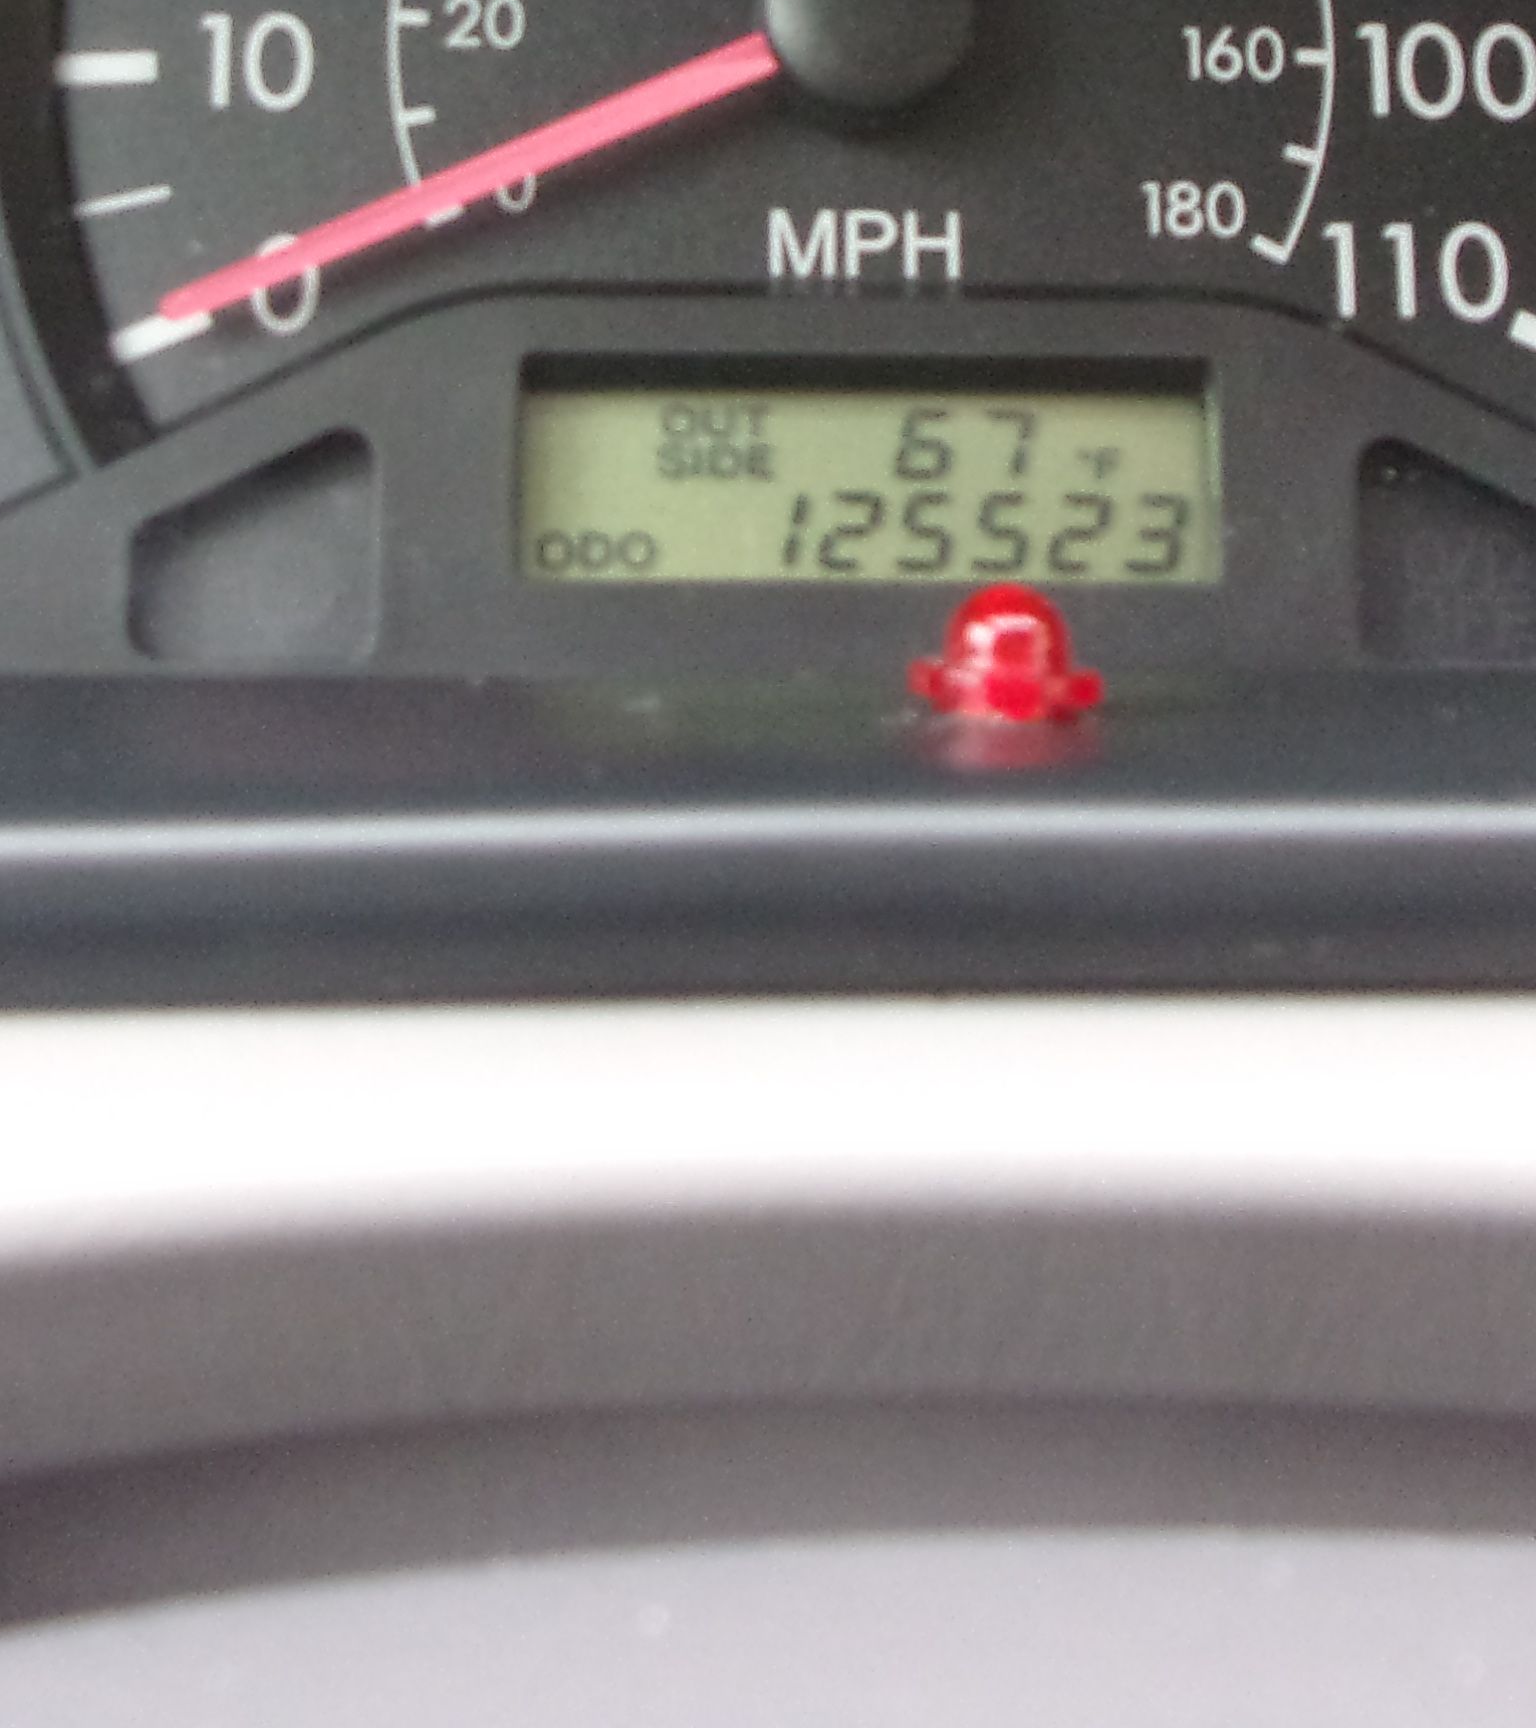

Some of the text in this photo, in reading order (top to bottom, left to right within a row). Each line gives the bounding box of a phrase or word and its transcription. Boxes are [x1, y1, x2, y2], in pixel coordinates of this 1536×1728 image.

[201, 12, 314, 111] 10
[1183, 26, 1285, 83] 160
[768, 208, 961, 279] MPH
[1142, 180, 1246, 239] 180
[250, 233, 320, 334] 0
[1323, 222, 1509, 322] 110
[660, 403, 770, 438] OUT
[895, 409, 1037, 480] 67
[659, 444, 774, 480] SIDE
[537, 492, 1192, 572] ODO 125523
